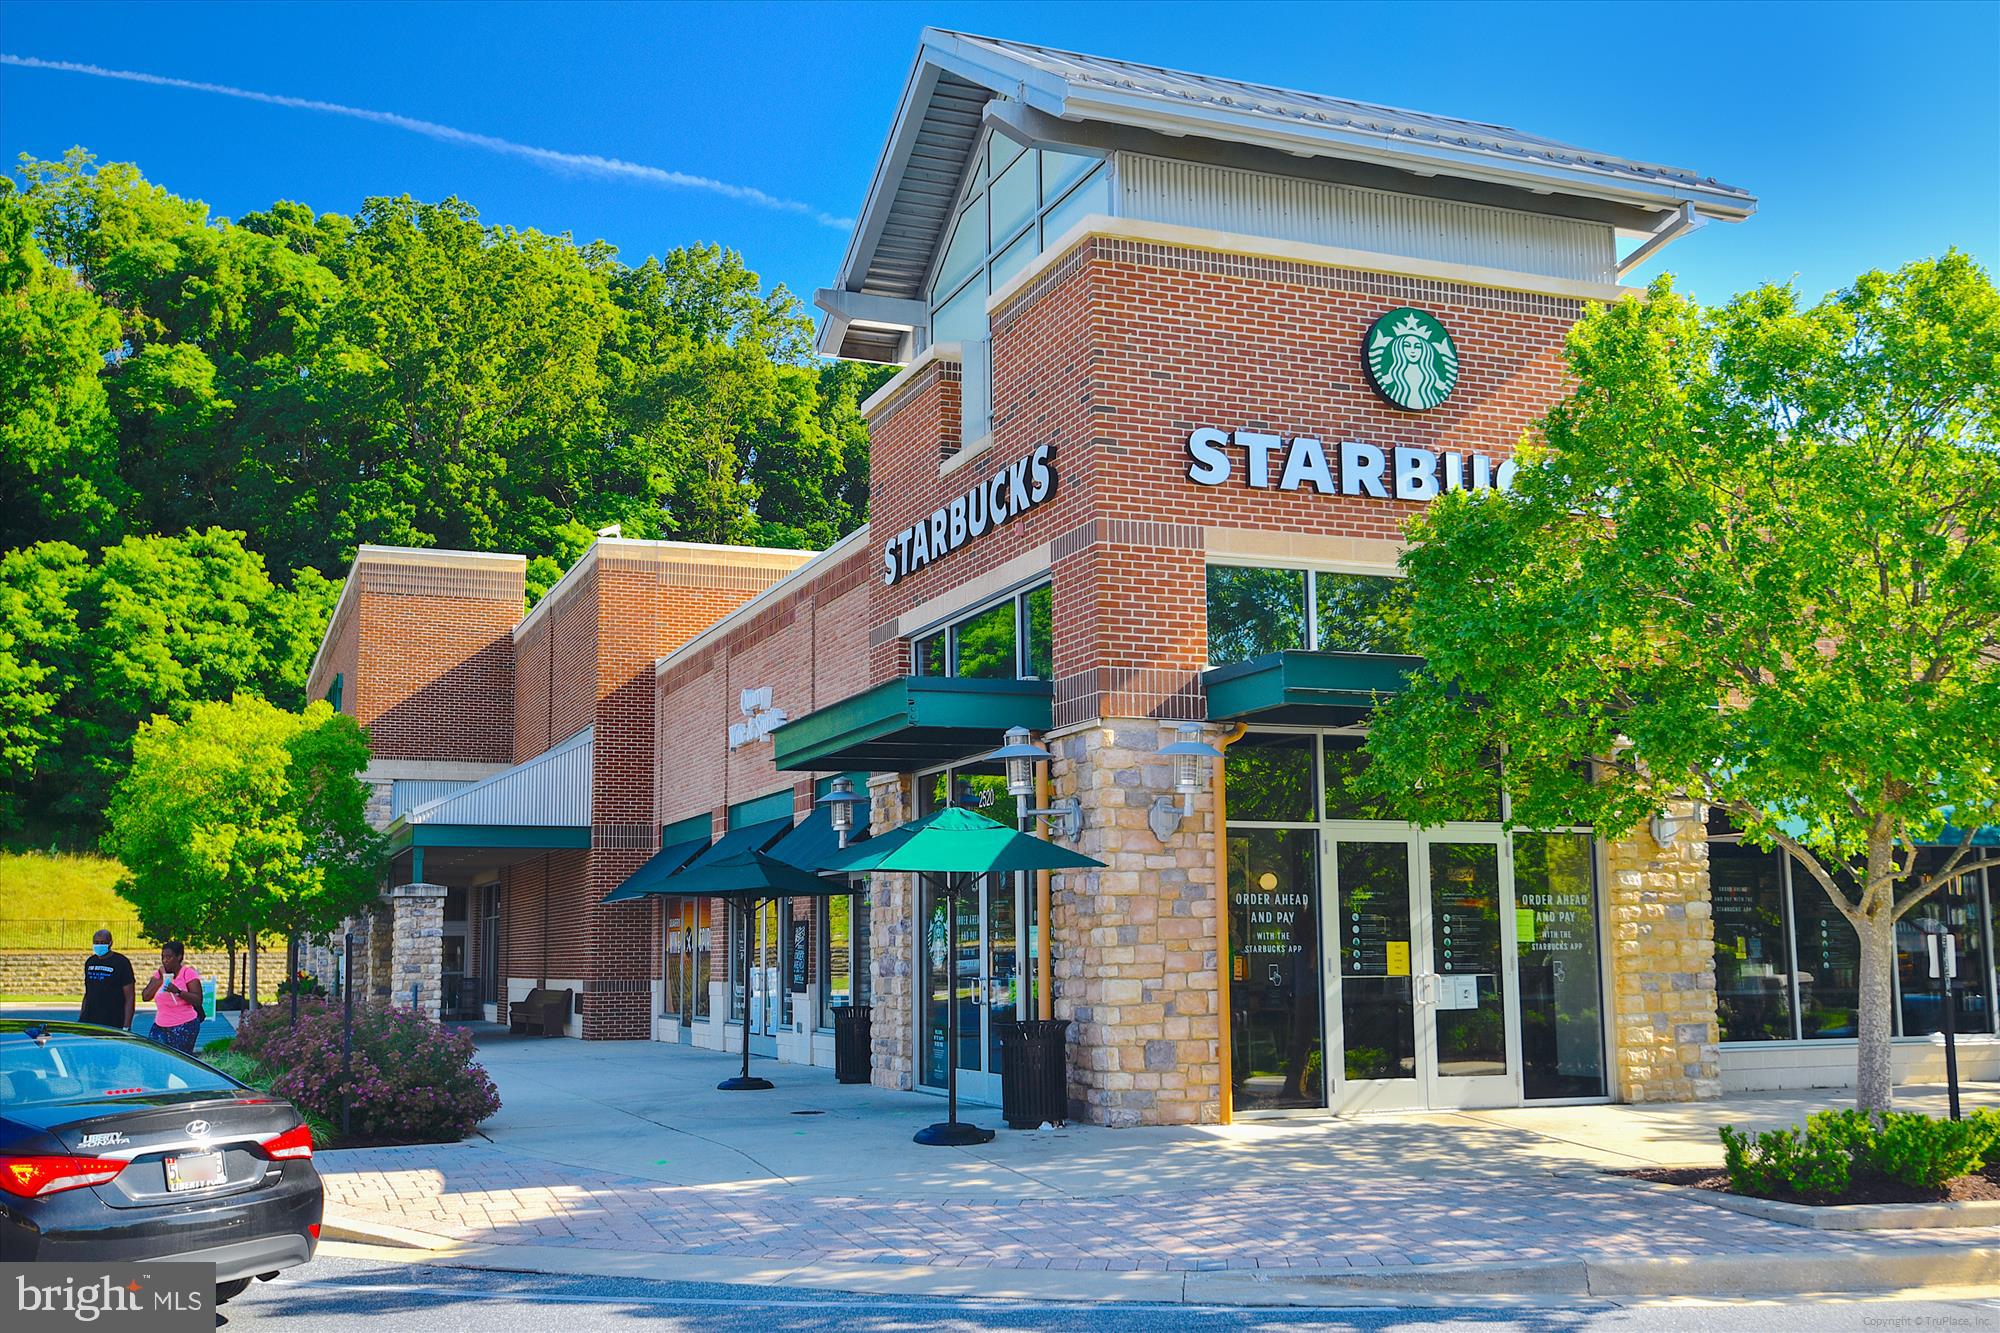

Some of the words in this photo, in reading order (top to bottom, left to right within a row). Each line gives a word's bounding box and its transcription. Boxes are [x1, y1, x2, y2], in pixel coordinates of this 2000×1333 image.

[1187, 427, 1575, 508] STARBU
[884, 444, 1053, 585] STARBUCKS
[1235, 893, 1270, 905] ORDER
[1274, 893, 1309, 905] AHEAD
[1522, 894, 1553, 905] ORDER
[1556, 894, 1588, 905] AHEAD
[1250, 911, 1273, 923] AND
[1276, 911, 1295, 923] PAY
[1536, 911, 1555, 923] AND
[1559, 911, 1576, 923] PAY
[1256, 931, 1275, 941] WITH
[1277, 931, 1290, 941] THE
[1542, 930, 1558, 939] WITH
[1560, 930, 1572, 939] THE
[1244, 945, 1286, 953] STARBUCKS
[1288, 945, 1303, 953] APP
[1531, 942, 1569, 951] STARBUCKS
[1570, 943, 1583, 951] APP
